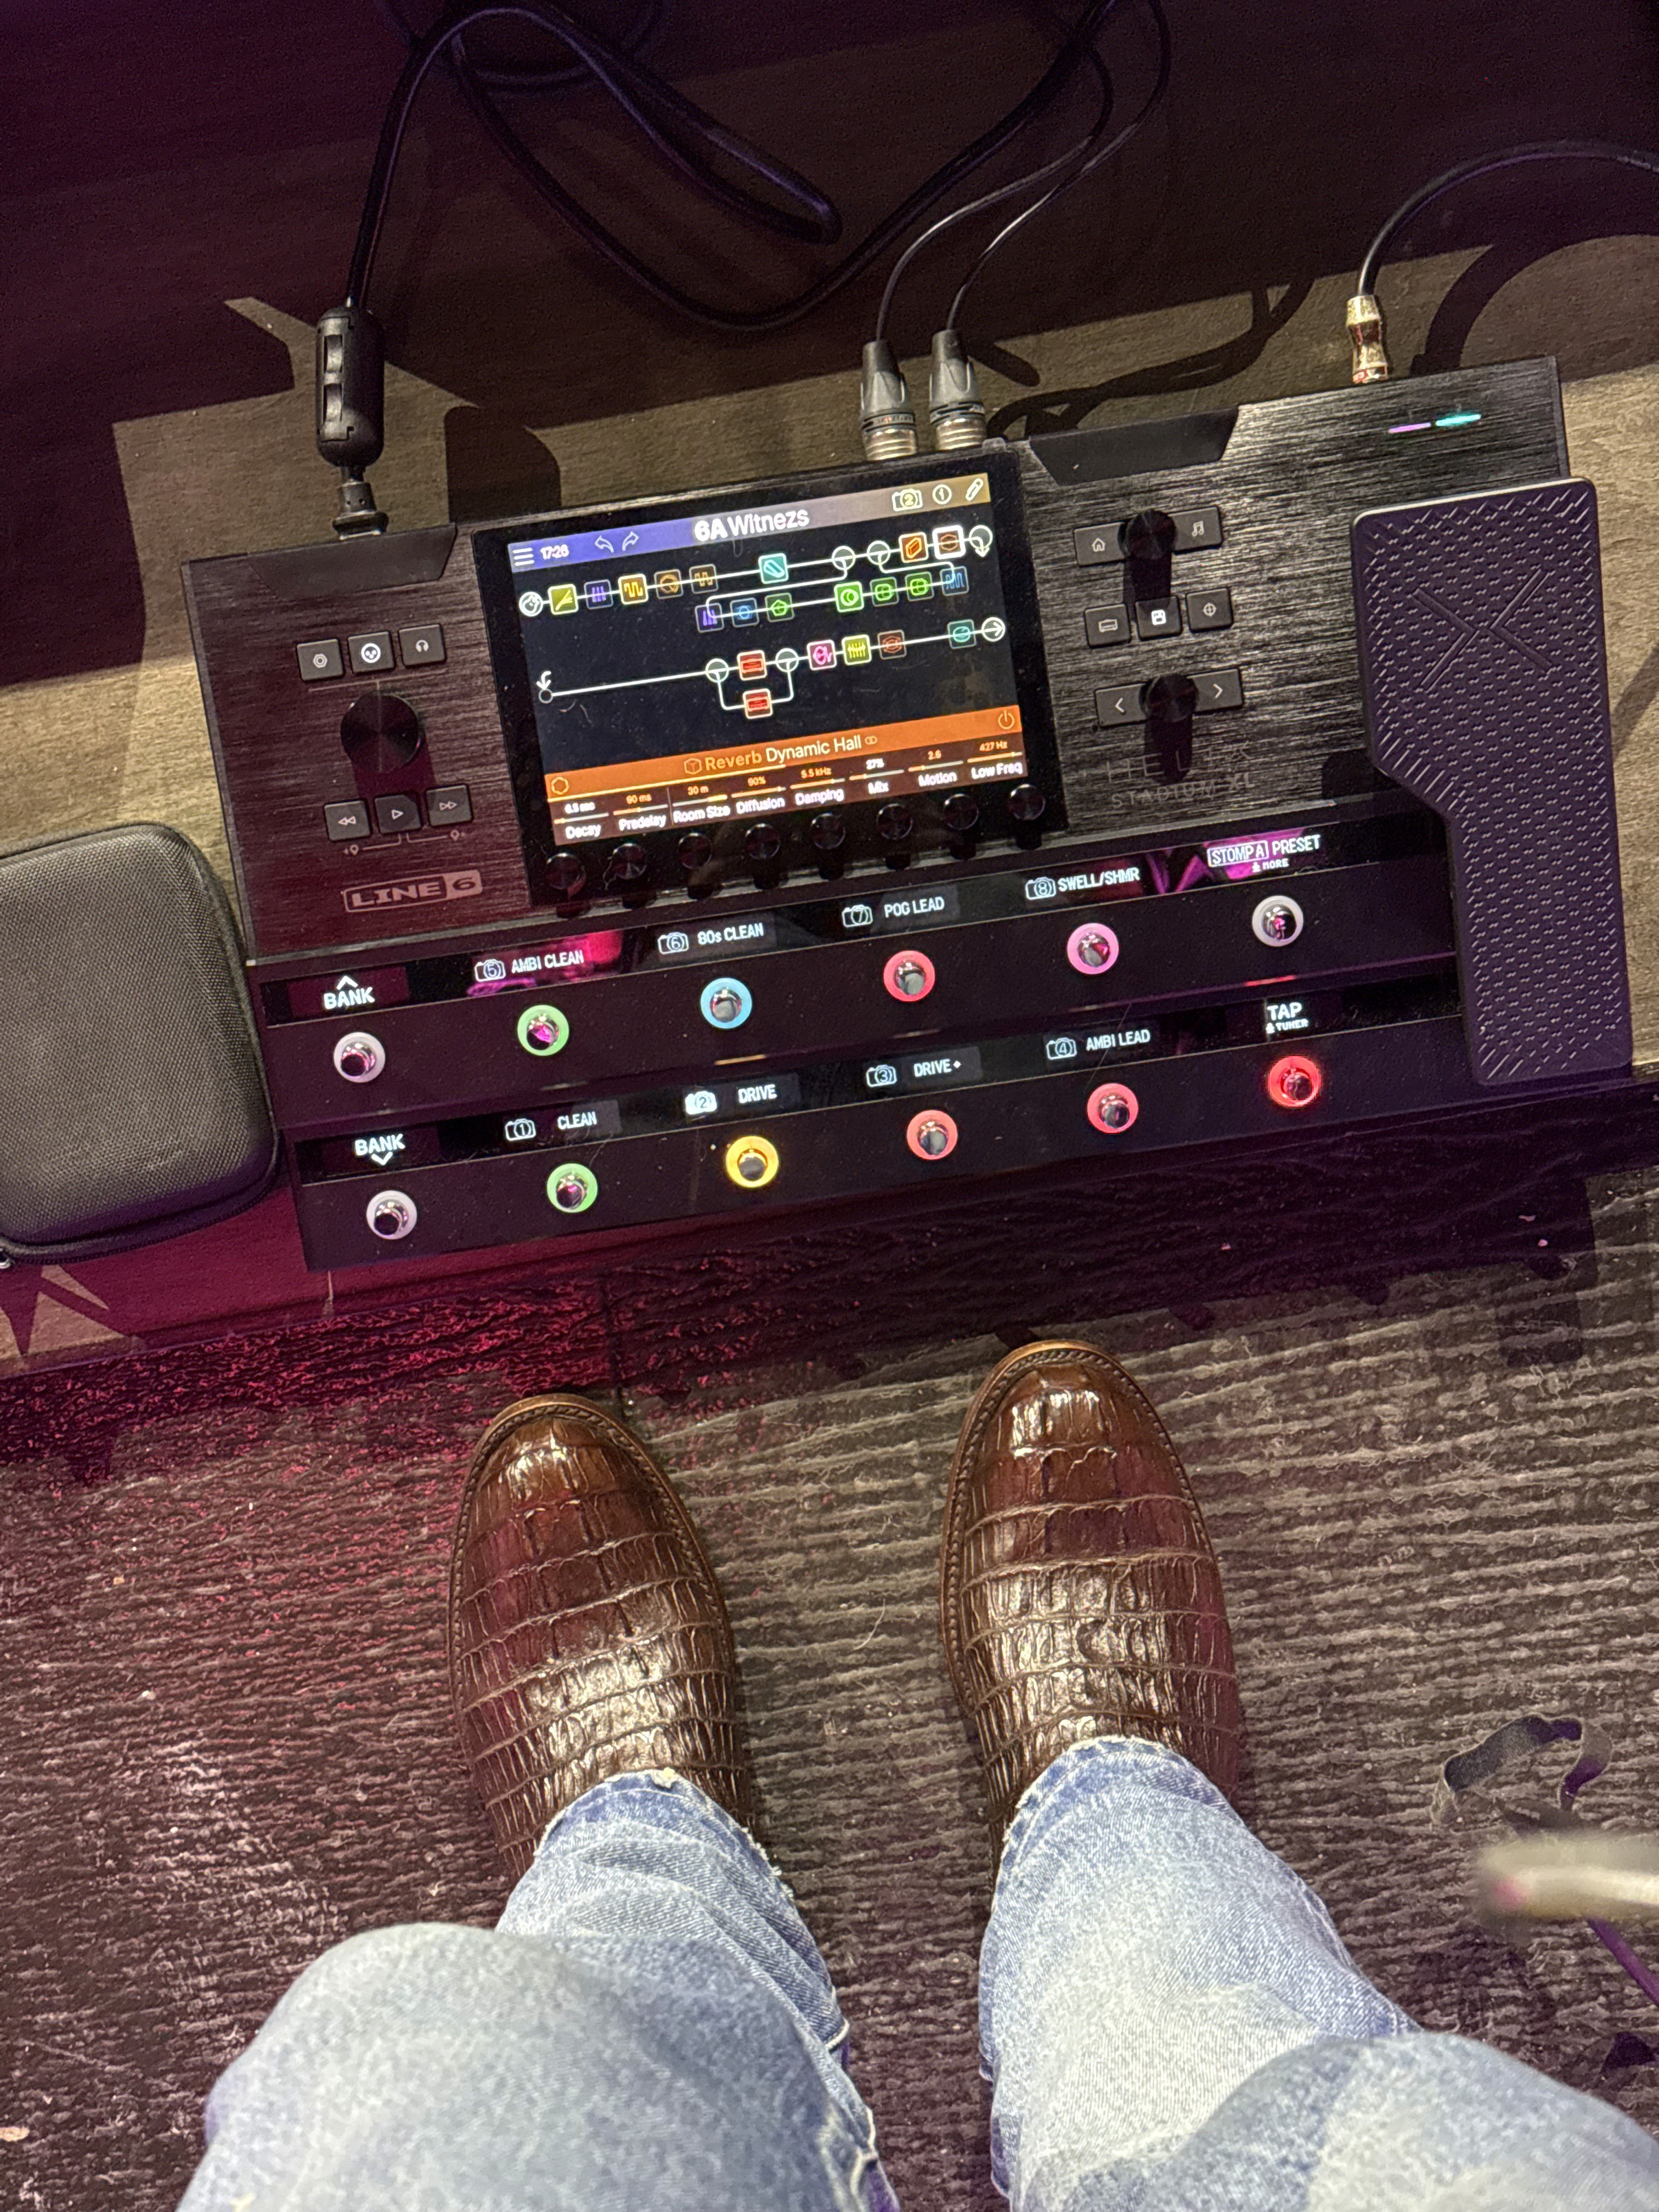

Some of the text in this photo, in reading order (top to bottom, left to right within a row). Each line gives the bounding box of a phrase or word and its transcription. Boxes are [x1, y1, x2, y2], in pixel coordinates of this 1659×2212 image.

[904, 493, 915, 506] 2
[694, 509, 810, 541] 6A Witnezs
[705, 735, 861, 771] Reverb Dynamic Hall
[995, 740, 1008, 751] Hz
[814, 766, 832, 777] kHz
[918, 770, 958, 787] Motion
[971, 760, 1023, 779] Low Freq
[699, 785, 709, 794] m
[868, 780, 889, 794] Mix
[1111, 772, 1255, 809] STADIUM XL
[638, 794, 652, 804] ms
[736, 797, 786, 814] Diffusion
[794, 788, 844, 806] Damping
[619, 814, 667, 832] Predelay
[673, 804, 731, 823] Room Size
[566, 823, 601, 839] Decay
[1211, 845, 1254, 865] STOMP
[1271, 834, 1321, 856] PRESET
[1262, 858, 1290, 870] MORE
[1037, 867, 1140, 894] 8 SWELL/SHMR
[351, 877, 476, 907] LINE 6
[855, 896, 945, 922] 7 POG LEAD
[670, 923, 764, 950] 6 80s CLEAN
[488, 950, 584, 977] 5 AMBI CLEAN
[323, 987, 375, 1010] BANK
[1267, 1001, 1302, 1020] TAP
[1275, 1018, 1309, 1031] TUNER
[1059, 1029, 1151, 1056] 4 AMBI LEAD
[879, 1070, 889, 1083] 3
[699, 1085, 777, 1109] 2 DRIVE
[518, 1111, 597, 1136] 1 CLEAN
[355, 1133, 406, 1156] BANK
